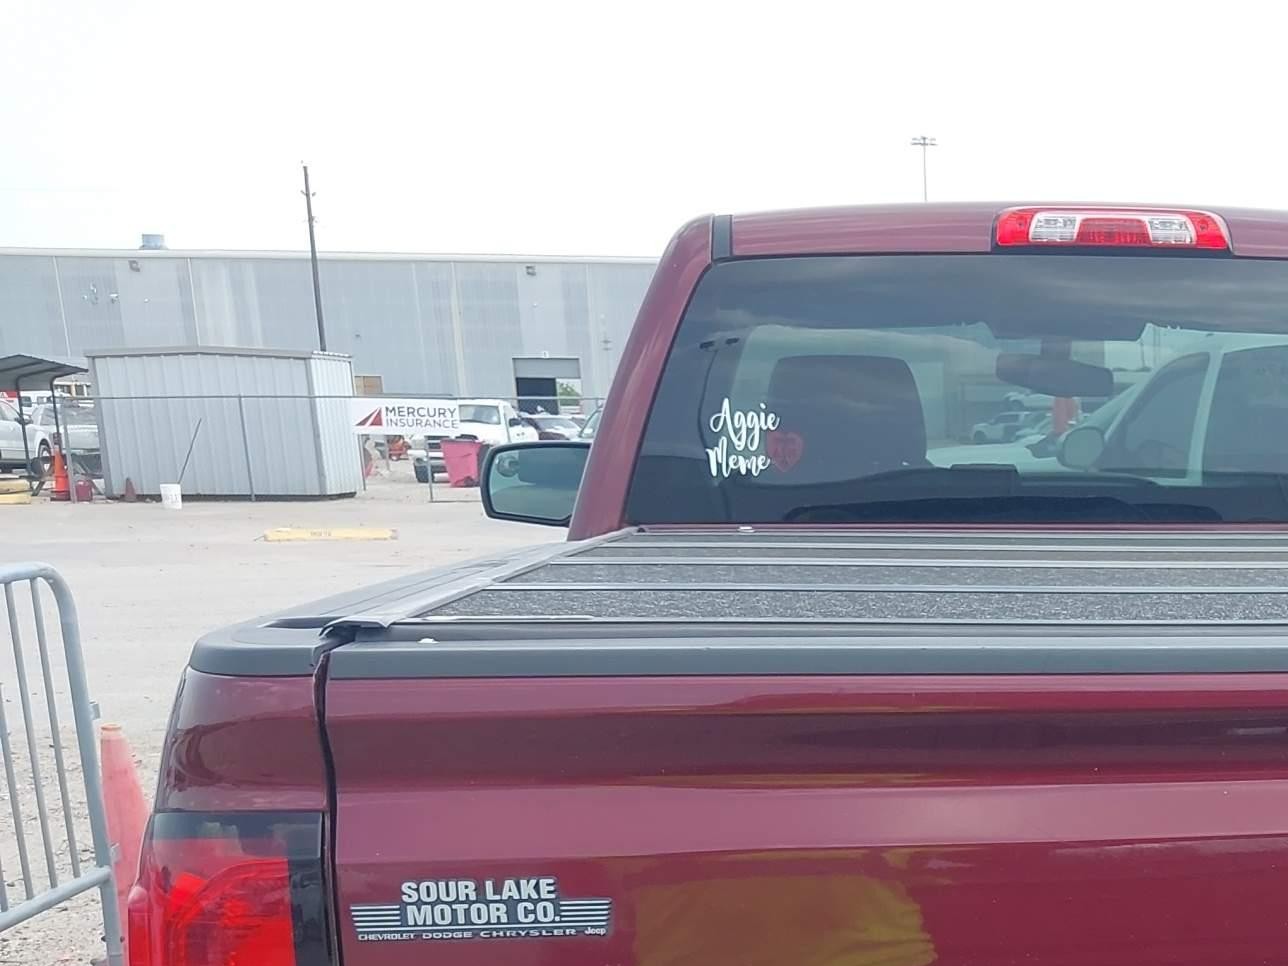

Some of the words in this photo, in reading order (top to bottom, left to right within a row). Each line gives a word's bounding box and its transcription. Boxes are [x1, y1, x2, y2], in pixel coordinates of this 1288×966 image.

[385, 406, 457, 418] MERCURY
[386, 418, 459, 429] INSURANCE
[709, 397, 781, 451] Aggie
[705, 436, 771, 477] Meme
[401, 880, 477, 903] SOUR
[485, 878, 556, 900] LAKE
[406, 902, 508, 926] MOTOR
[517, 901, 560, 923] CO.
[358, 932, 416, 941] CHEVROLET
[422, 931, 473, 939] DODGE
[479, 928, 577, 938] CHRYSLER
[584, 926, 607, 936] Jeep
